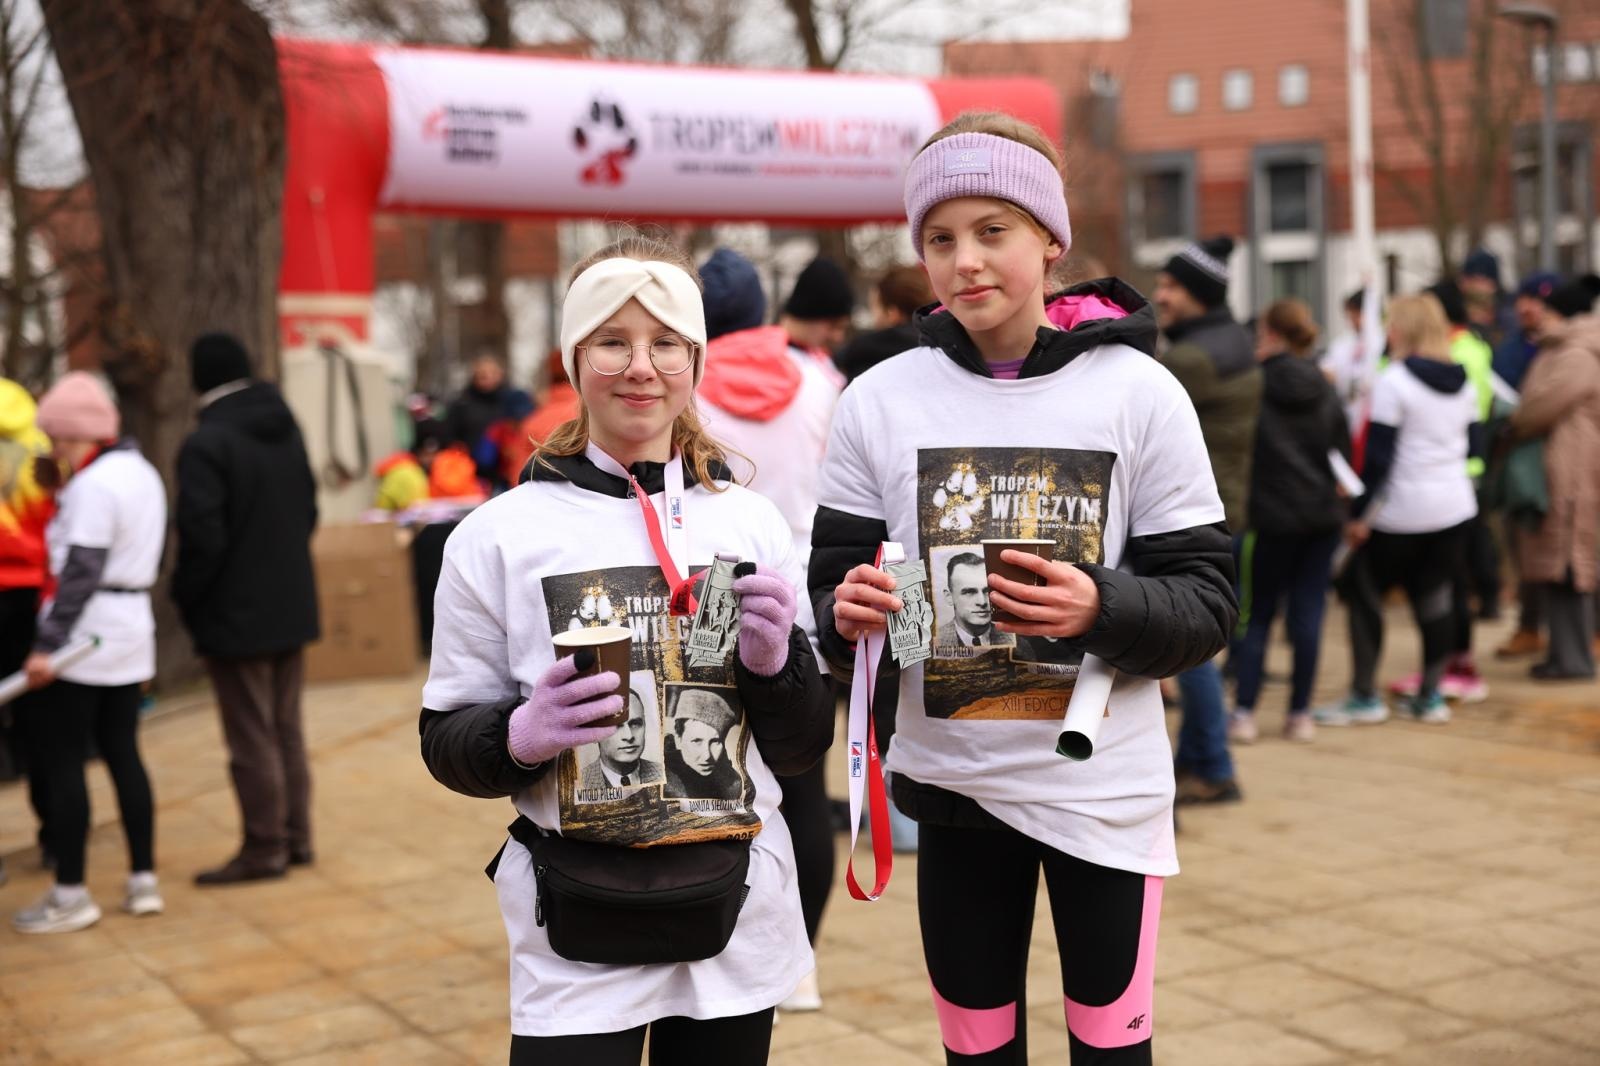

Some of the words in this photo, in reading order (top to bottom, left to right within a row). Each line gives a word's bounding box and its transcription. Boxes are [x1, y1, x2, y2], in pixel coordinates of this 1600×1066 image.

[990, 475, 1048, 491] TROPEM
[990, 493, 1101, 523] WILCZYM
[624, 596, 671, 613] TROPE
[628, 615, 692, 643] WILC
[954, 645, 973, 657] PILECKI
[1002, 696, 1020, 711] XIII
[577, 788, 598, 801] WITOLD
[600, 787, 623, 800] PILECKI
[689, 800, 709, 812] DANUTA
[1126, 1013, 1146, 1030] 4F
